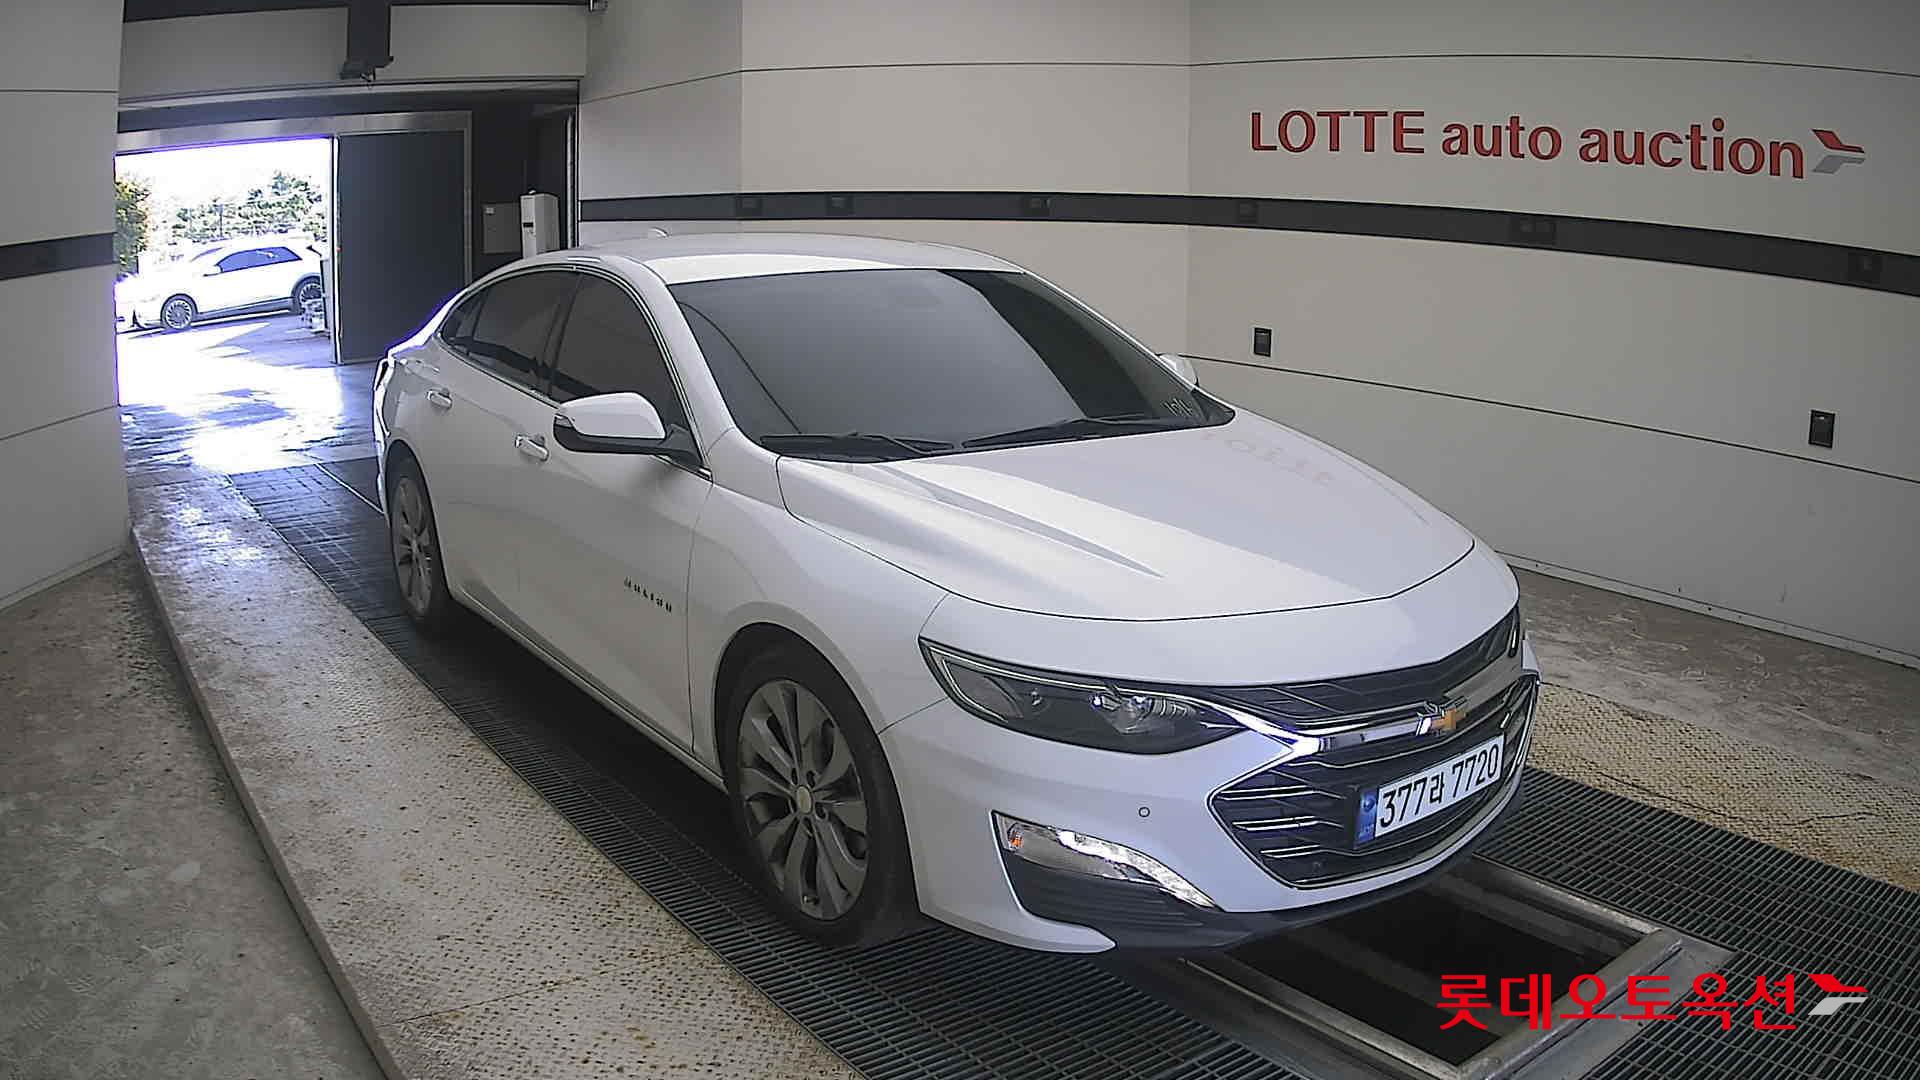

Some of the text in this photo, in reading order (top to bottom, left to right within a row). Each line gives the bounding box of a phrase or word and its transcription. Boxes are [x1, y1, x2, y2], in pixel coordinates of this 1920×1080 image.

[1251, 110, 1805, 180] LOTTE auto auction
[1380, 743, 1499, 828] 377라 7720
